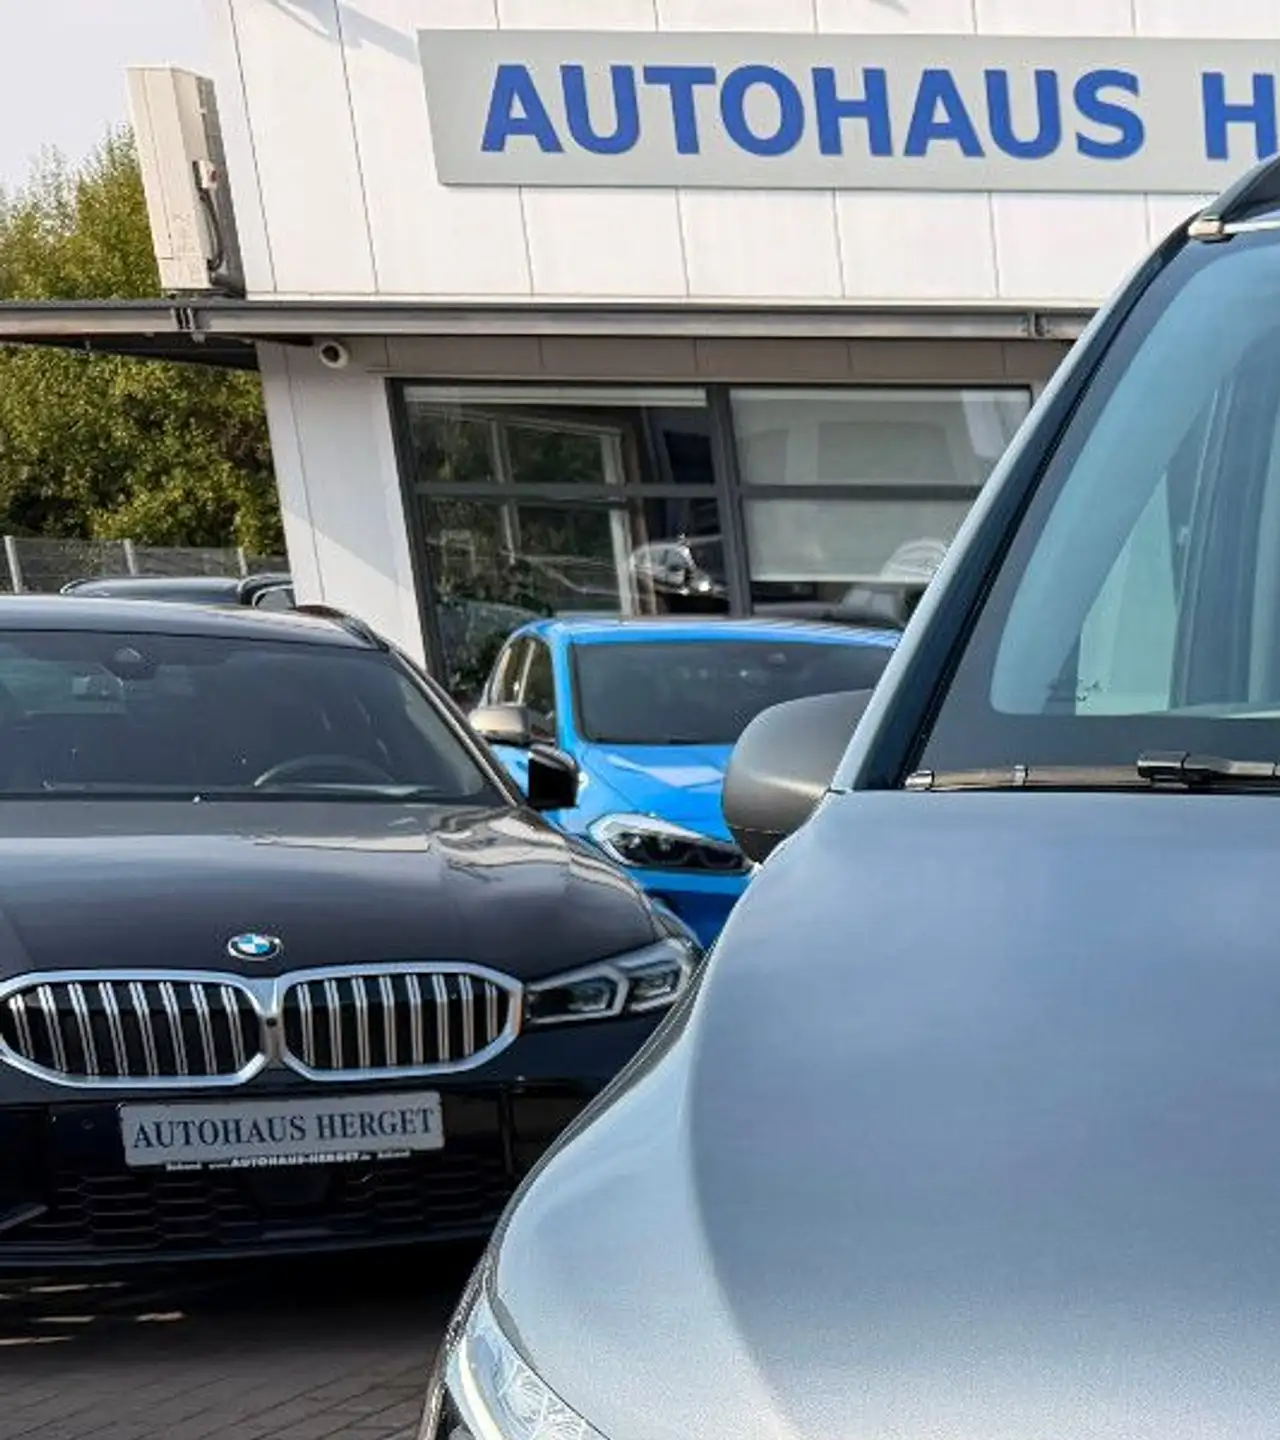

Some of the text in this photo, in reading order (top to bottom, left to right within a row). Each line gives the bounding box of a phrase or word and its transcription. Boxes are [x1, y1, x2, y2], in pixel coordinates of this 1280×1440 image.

[482, 64, 1146, 161] AUTOHAUS
[133, 1107, 435, 1149] AUTOHAUS HERGET
